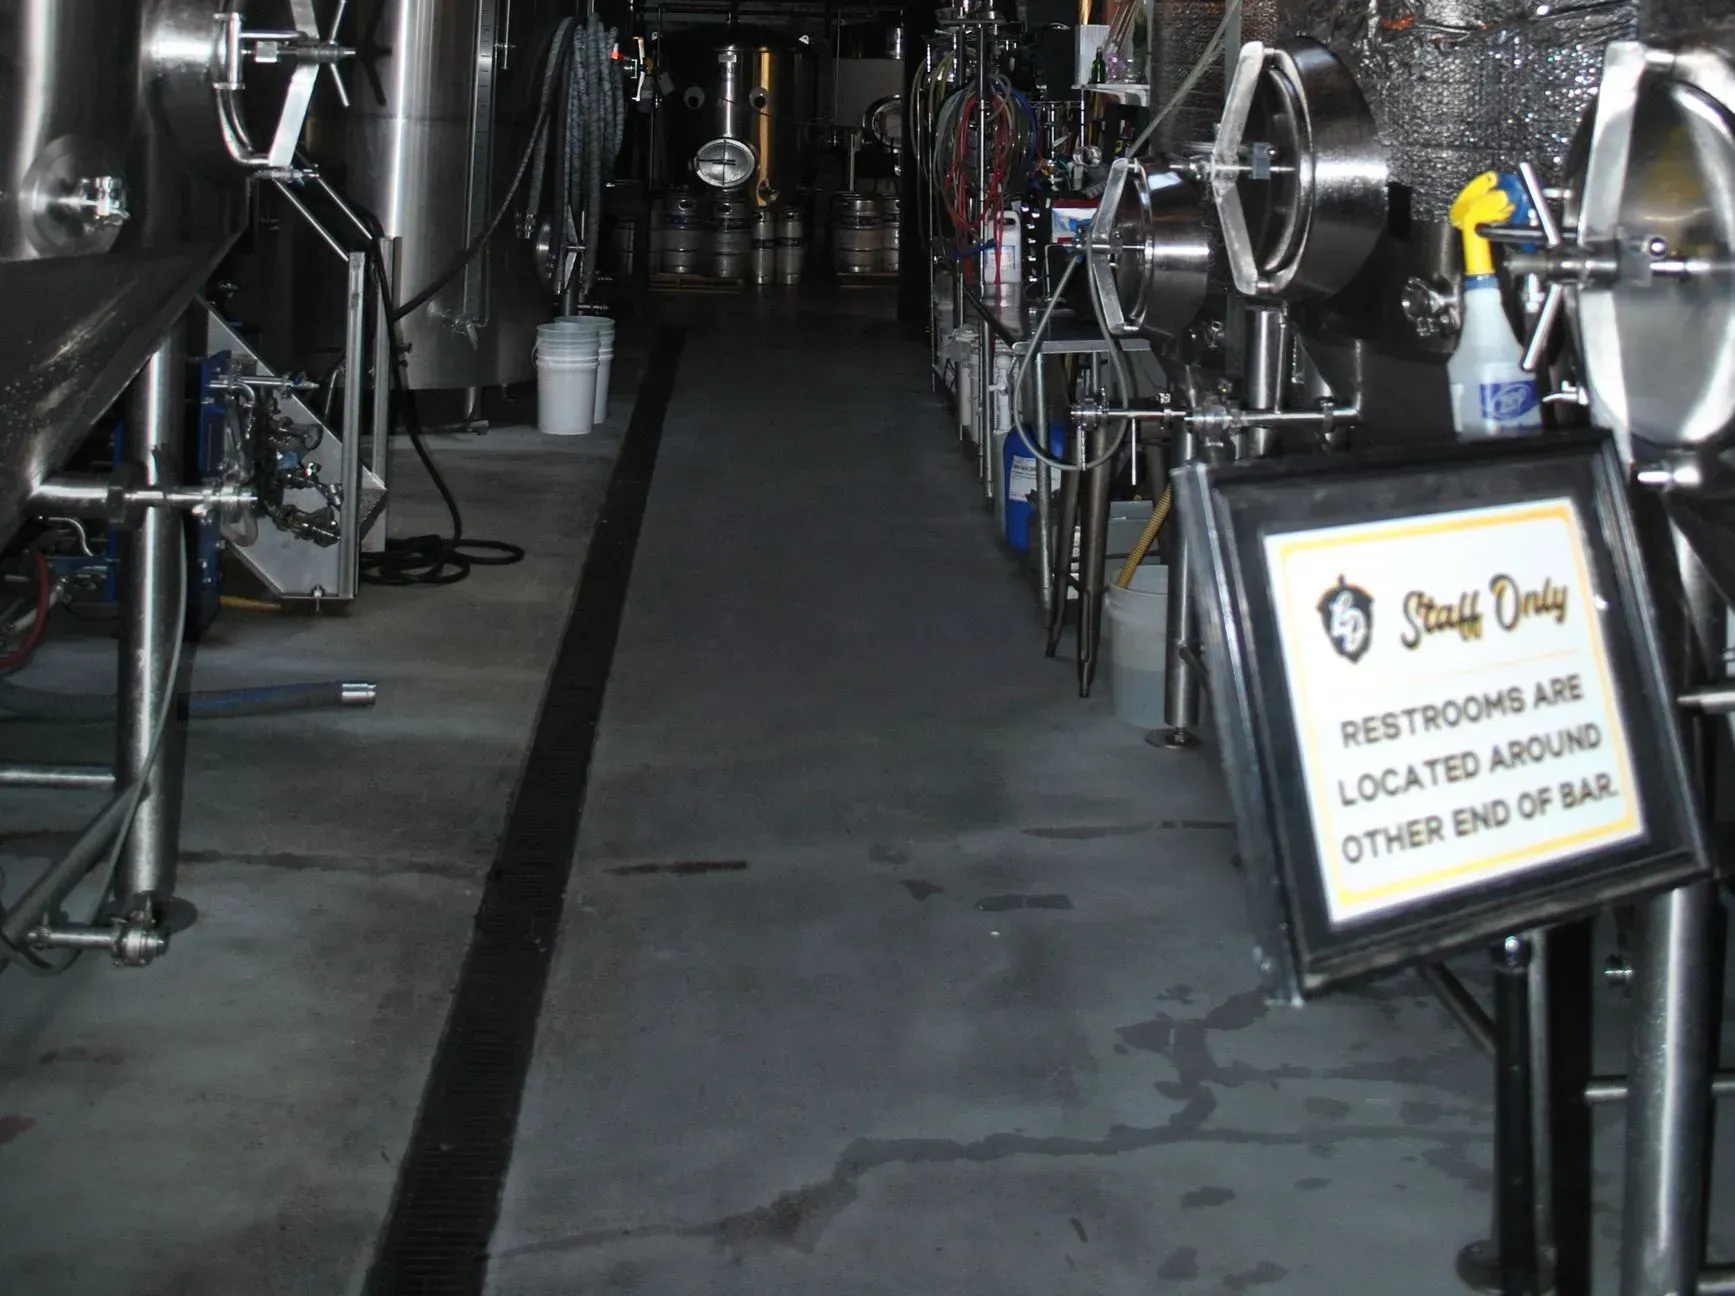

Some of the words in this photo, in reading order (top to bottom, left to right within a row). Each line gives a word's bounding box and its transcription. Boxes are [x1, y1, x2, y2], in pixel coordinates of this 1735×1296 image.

[1401, 590, 1483, 650] Staff
[1489, 573, 1568, 633] Only
[1341, 686, 1525, 748] RESTROOMS
[1534, 673, 1584, 709] ARE
[1338, 751, 1480, 807] LOCATED
[1490, 722, 1602, 773] AROUND
[1341, 814, 1445, 864] OTHER
[1452, 799, 1511, 838] END
[1517, 786, 1552, 819] OF
[1559, 772, 1619, 810] BAR.
